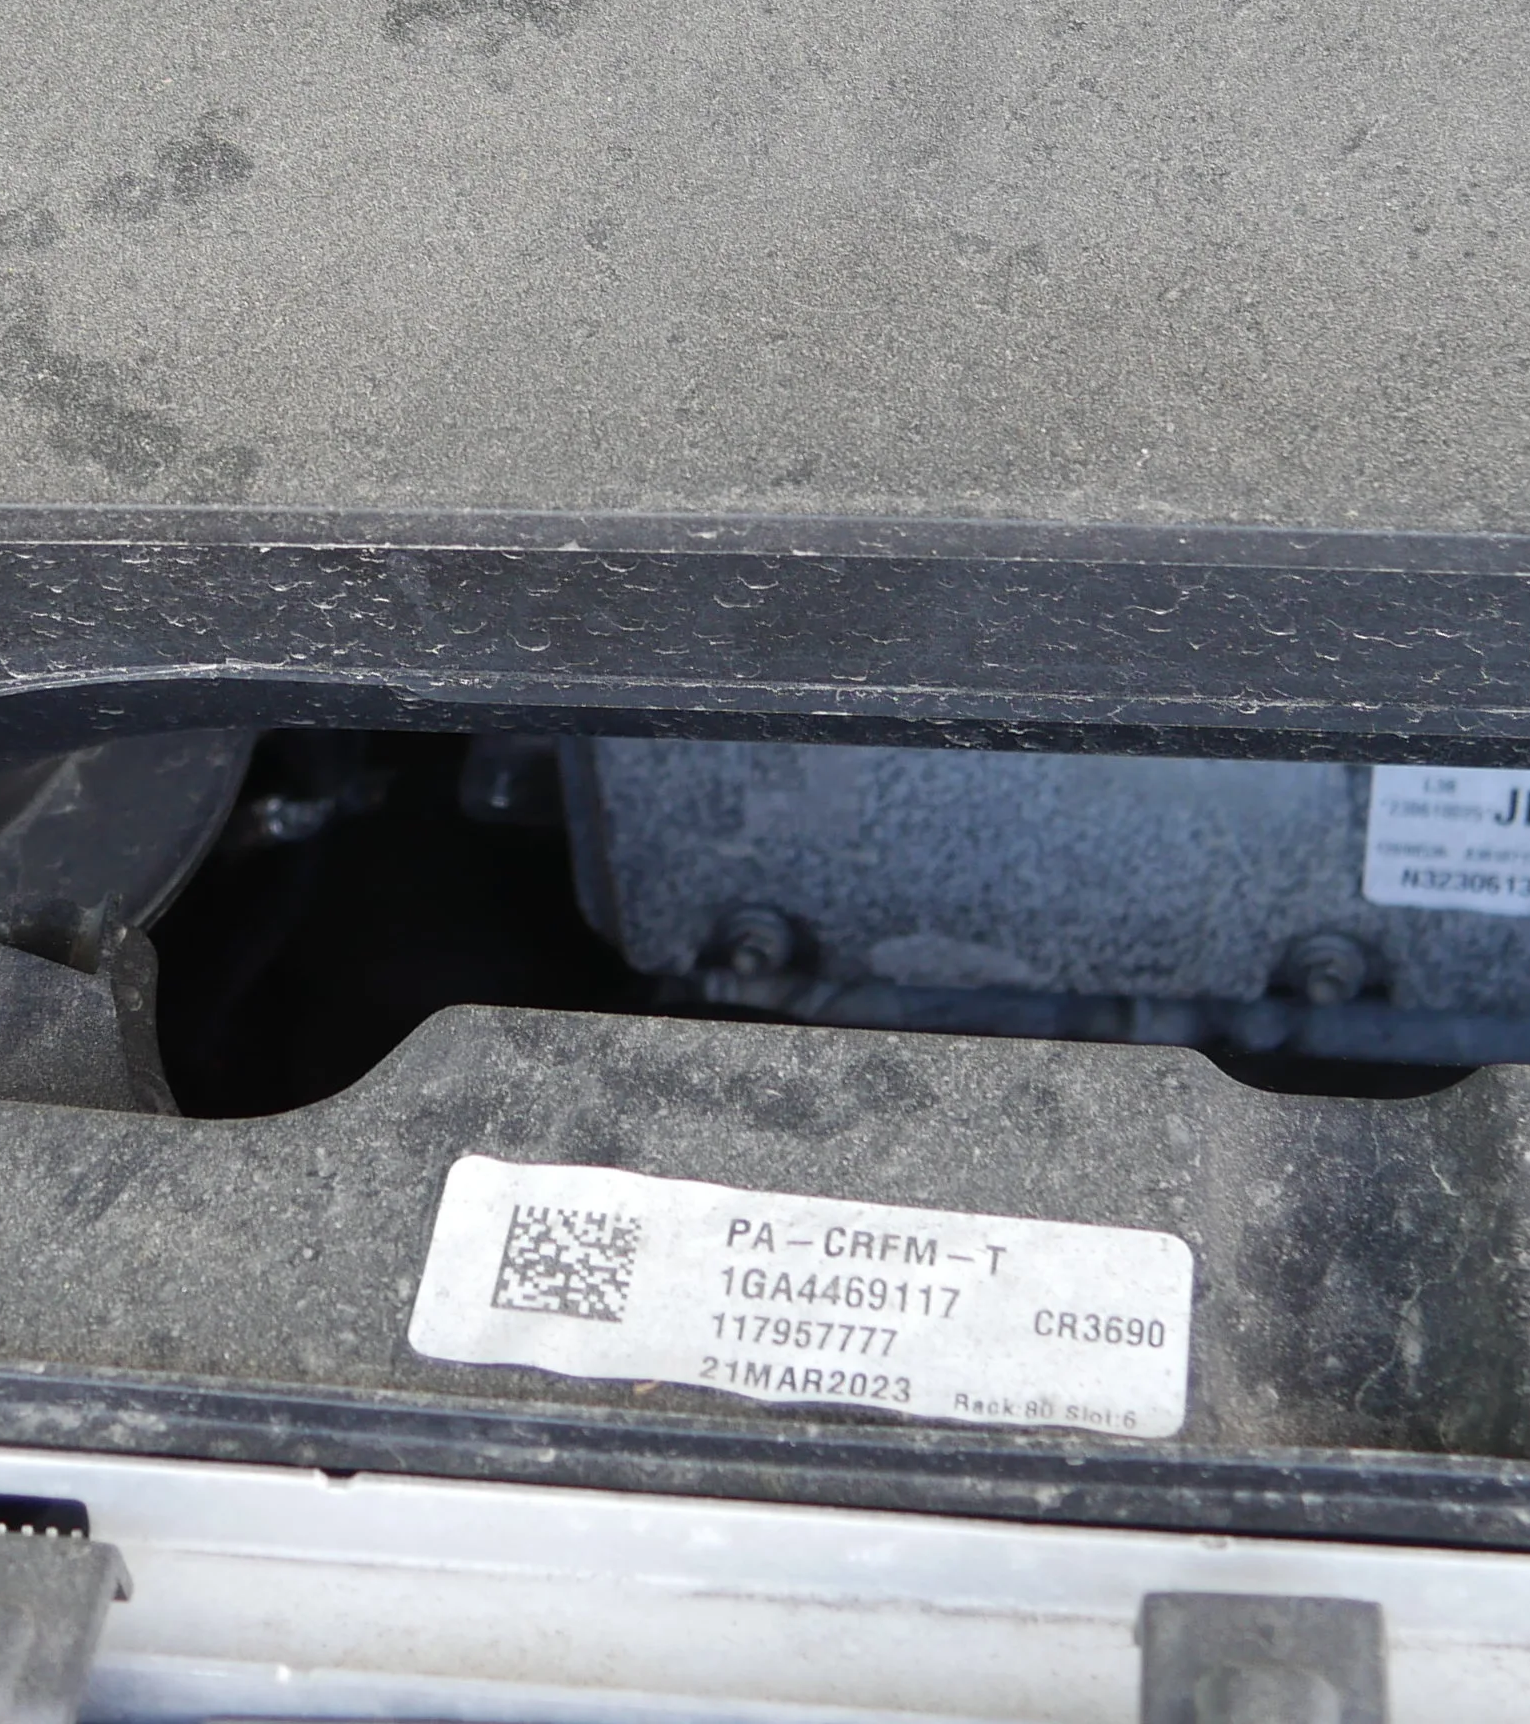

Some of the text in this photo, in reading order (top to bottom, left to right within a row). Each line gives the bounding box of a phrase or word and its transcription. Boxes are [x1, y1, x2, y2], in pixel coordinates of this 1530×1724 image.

[720, 1266, 962, 1319] 1GA4469117
[711, 1311, 899, 1358] 117957777
[1033, 1308, 1166, 1349] CR3690
[698, 1356, 912, 1404] 21MAR2023
